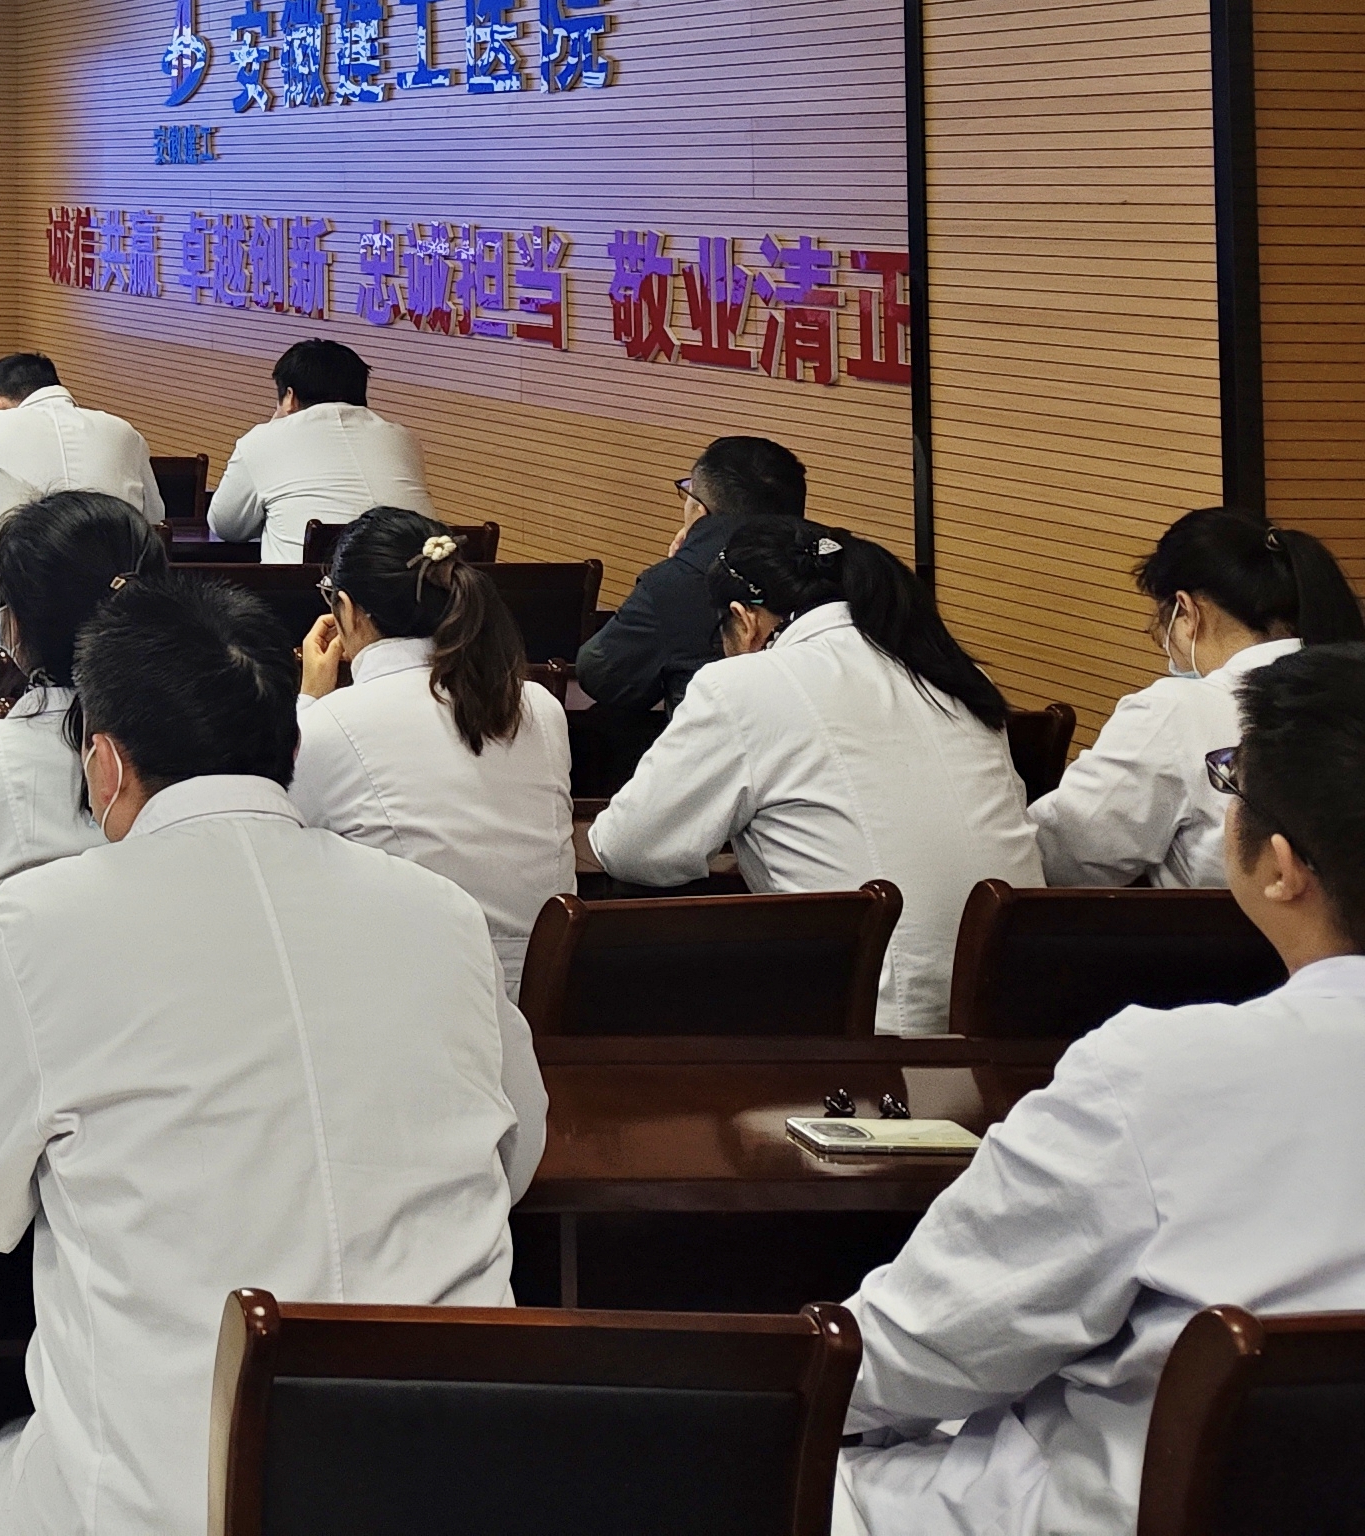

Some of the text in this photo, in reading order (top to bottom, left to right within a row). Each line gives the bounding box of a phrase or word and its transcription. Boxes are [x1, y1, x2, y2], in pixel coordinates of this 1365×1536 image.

[46, 205, 911, 386] 诚信共赢 卓越创新 忠诚担当 敬业清正
